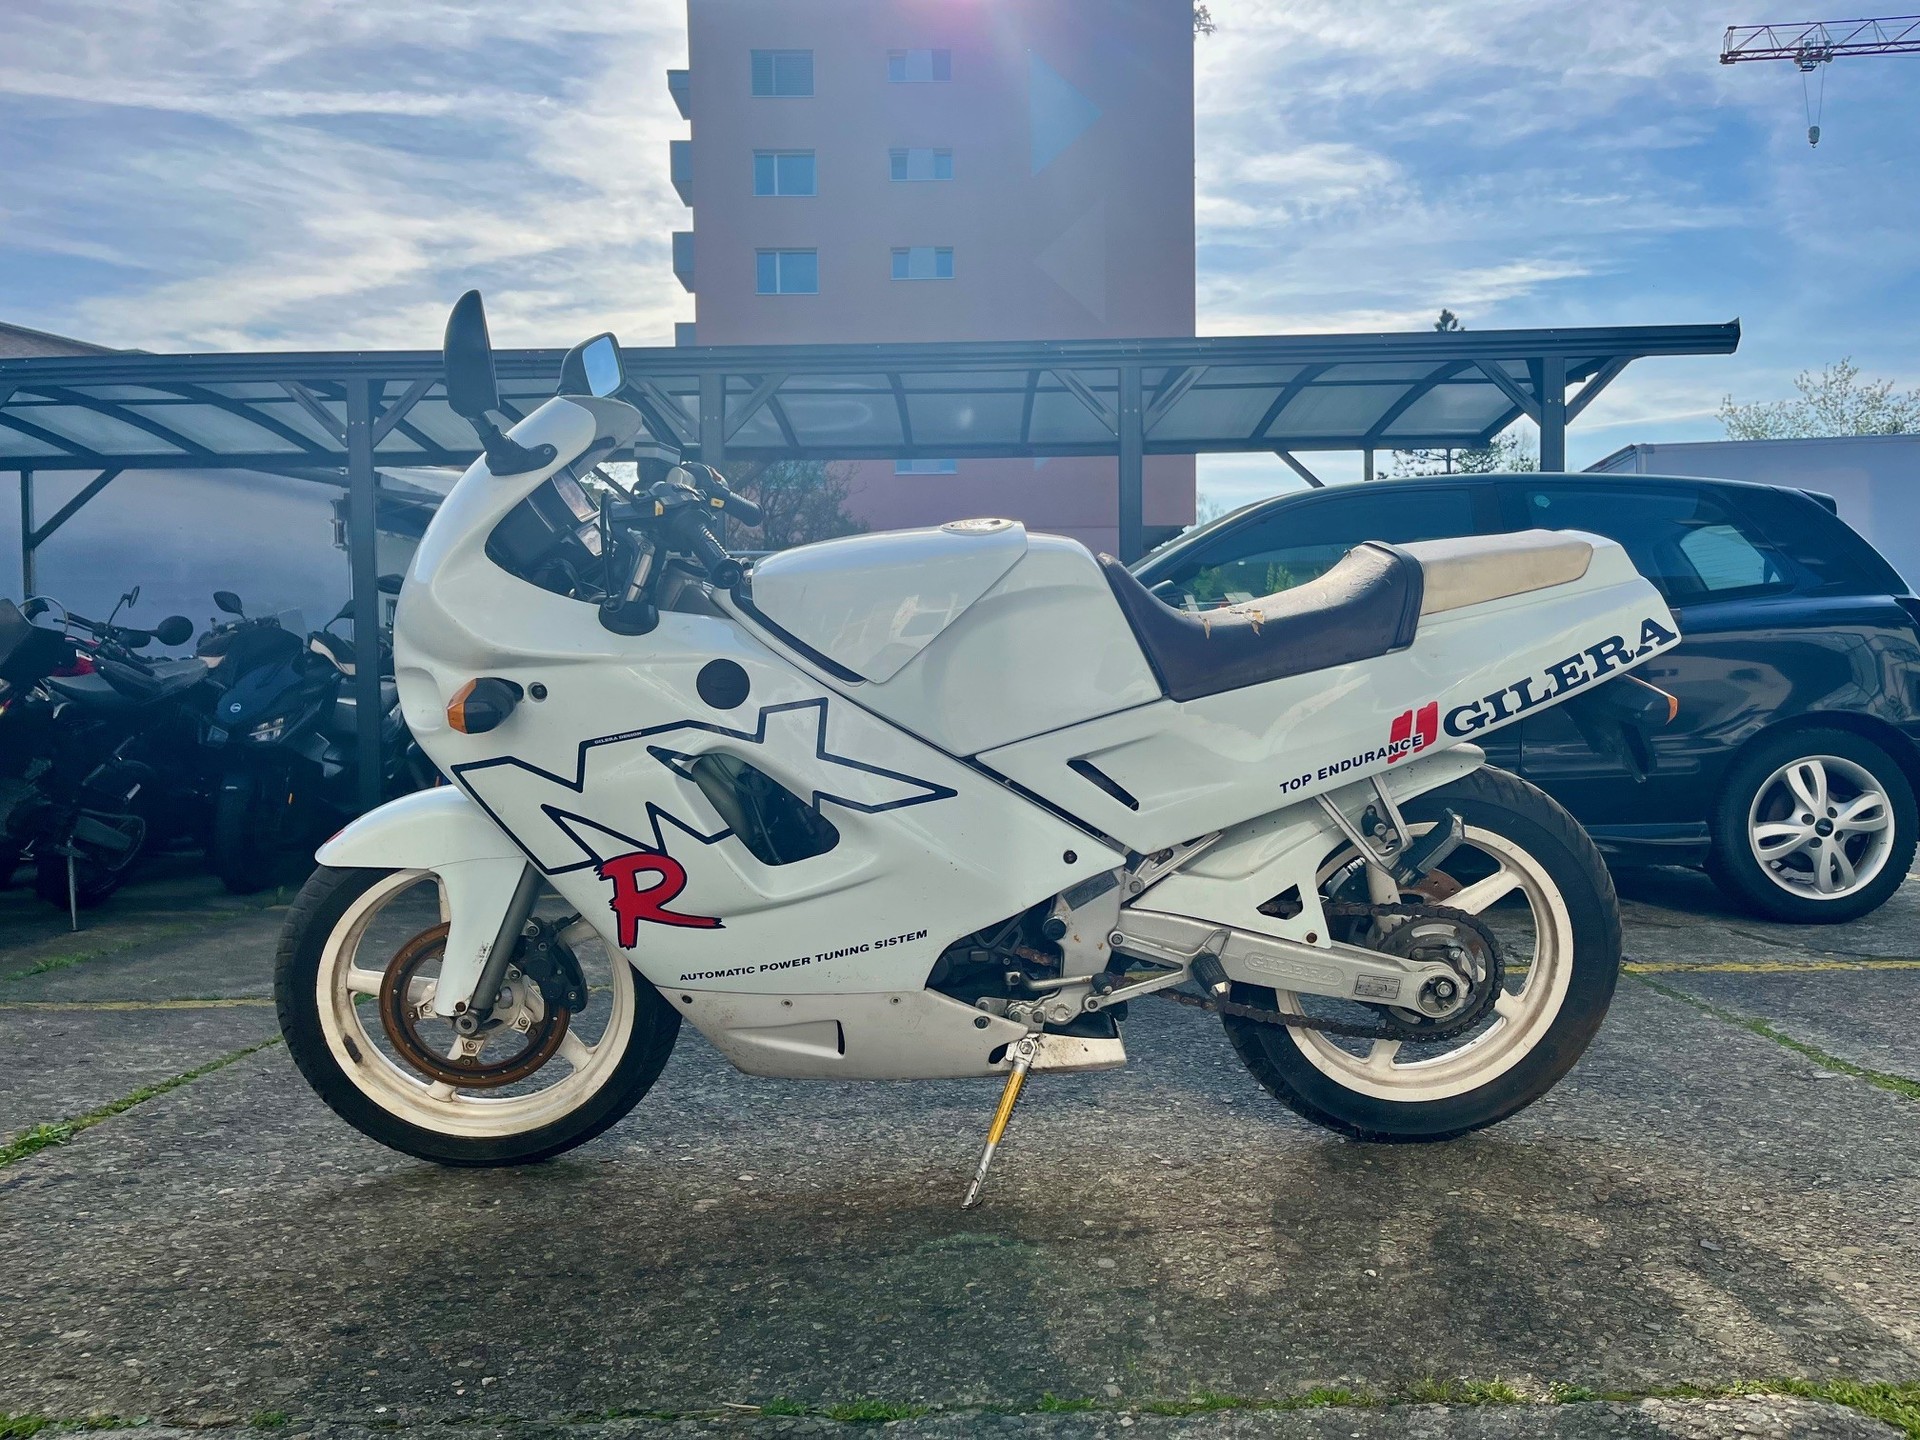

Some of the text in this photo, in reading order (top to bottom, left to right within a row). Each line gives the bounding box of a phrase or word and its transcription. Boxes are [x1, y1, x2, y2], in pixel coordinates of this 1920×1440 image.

[1443, 617, 1677, 738] GILERA
[1279, 733, 1423, 795] TOP ENDURANCE
[592, 851, 726, 950] R
[679, 928, 928, 982] AUTOMATIC POWER TUNING SISTEM
[1248, 954, 1336, 982] GILERA
